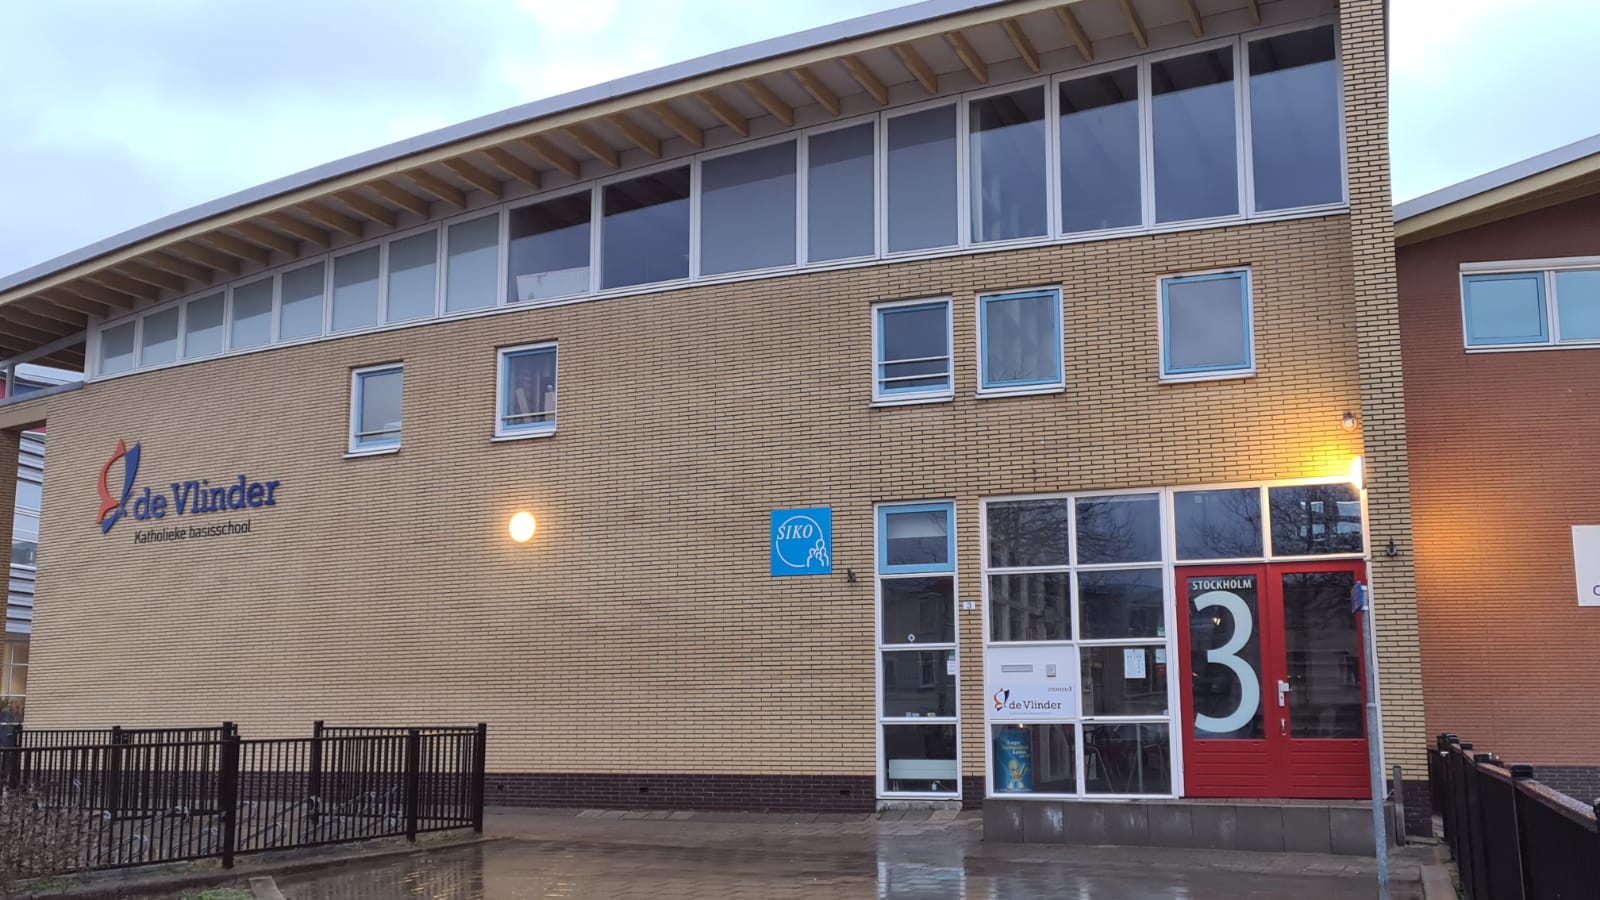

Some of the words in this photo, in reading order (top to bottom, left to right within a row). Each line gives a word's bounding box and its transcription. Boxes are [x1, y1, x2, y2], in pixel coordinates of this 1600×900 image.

[133, 487, 167, 521] de
[171, 474, 280, 515] Vlinder
[134, 528, 186, 544] Katholieke
[189, 518, 251, 538] basisschool
[777, 515, 814, 540] SIKO
[1192, 579, 1252, 590] STOCKHOLM
[966, 602, 972, 610] 3
[1193, 590, 1260, 733] 3
[1009, 701, 1022, 710] de
[1023, 700, 1062, 710] Vlinder
